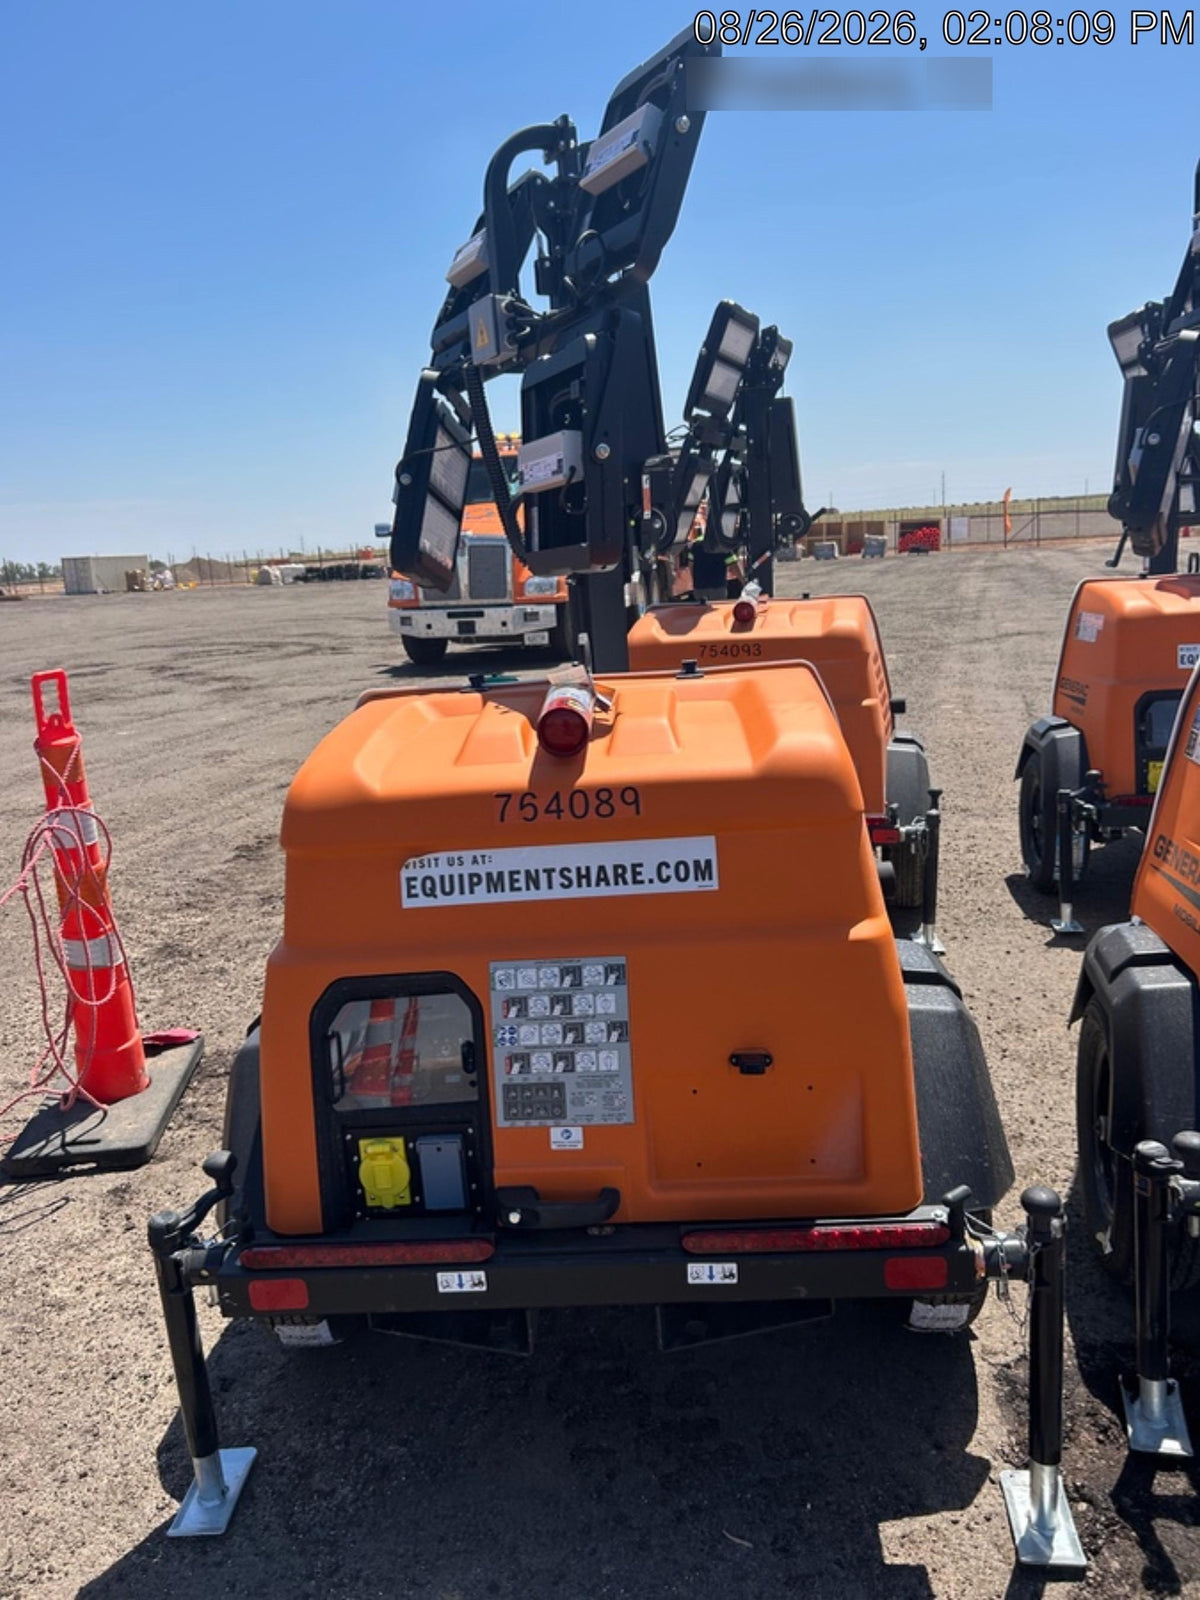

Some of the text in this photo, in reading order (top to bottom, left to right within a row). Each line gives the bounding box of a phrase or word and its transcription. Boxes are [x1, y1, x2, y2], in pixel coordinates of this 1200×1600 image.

[699, 643, 762, 658] 754093
[447, 856, 464, 867] US
[471, 854, 493, 866] AT:
[405, 858, 713, 899] EQUIPMENTSHARE.COM
